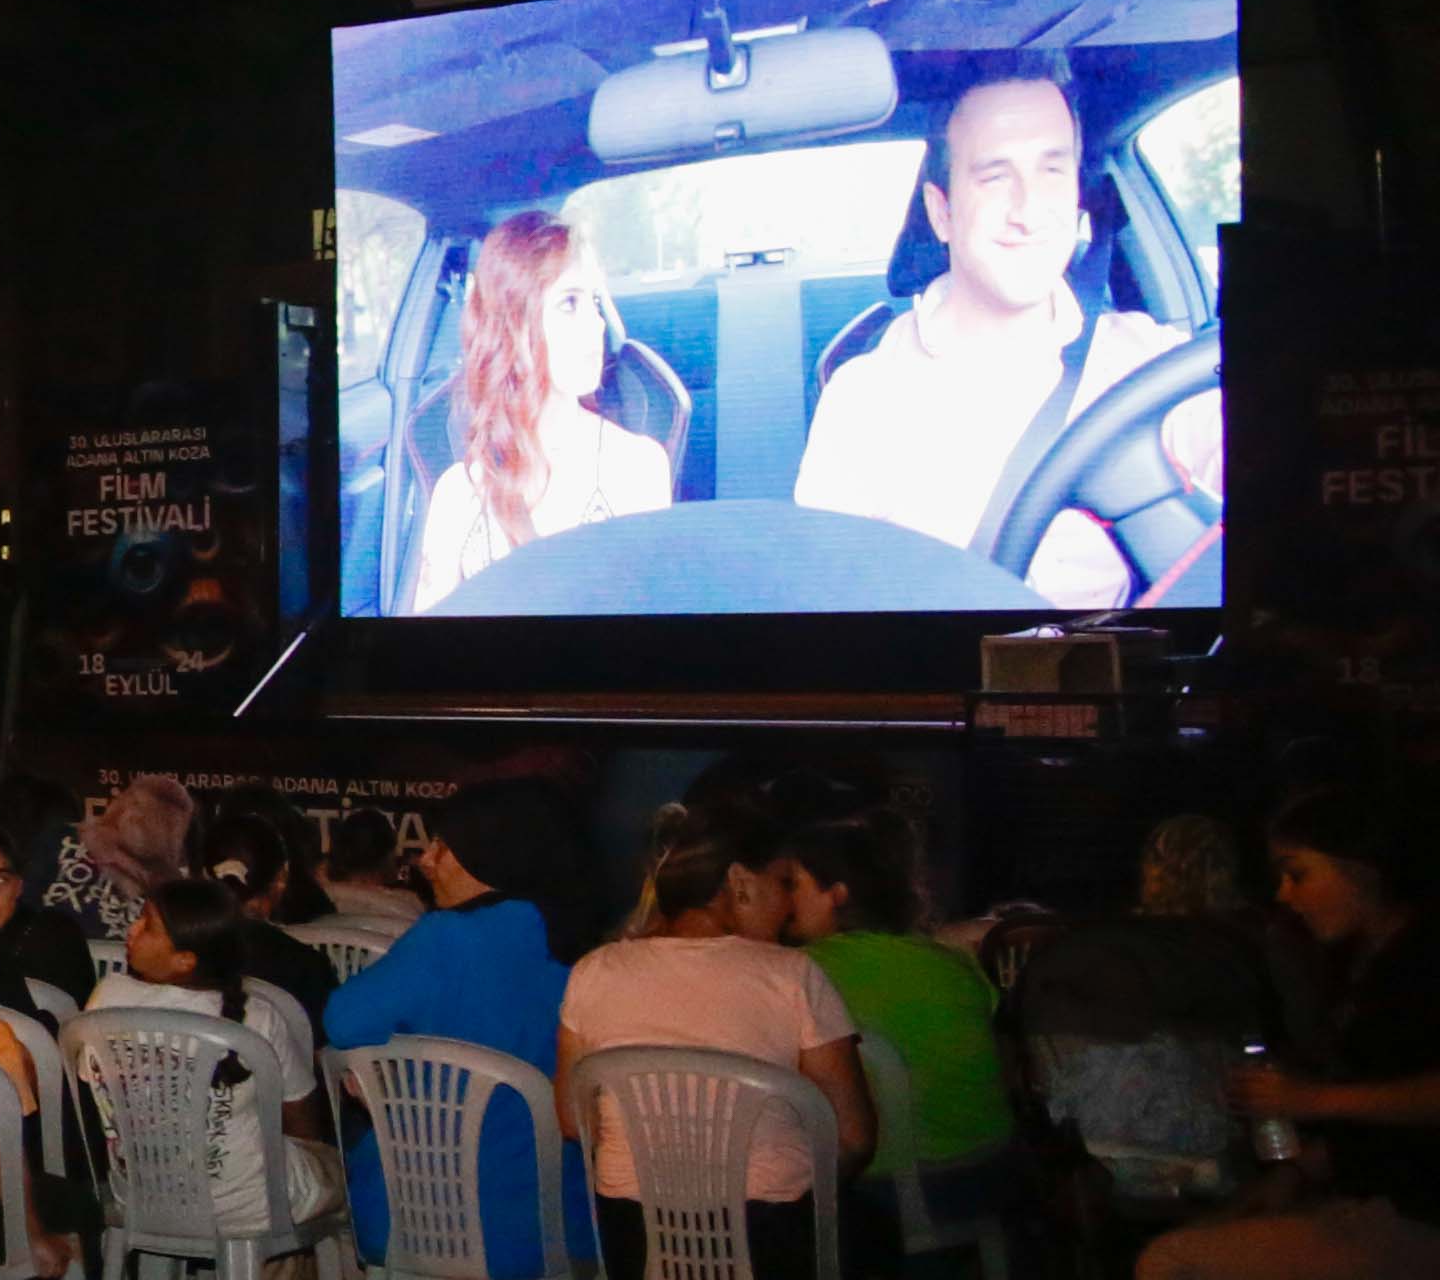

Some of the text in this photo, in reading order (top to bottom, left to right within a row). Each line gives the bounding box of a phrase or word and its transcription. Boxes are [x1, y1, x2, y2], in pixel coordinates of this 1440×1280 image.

[92, 425, 208, 448] ULUSLARARASI
[65, 443, 212, 468] ADANA ALTIN KOZA
[99, 467, 168, 504] FİLM
[65, 495, 212, 538] FESTİVALİ
[79, 649, 204, 676] 18 24
[104, 667, 179, 697] EYLÜL
[271, 774, 338, 796] ADANA
[344, 777, 400, 798] ALTIN
